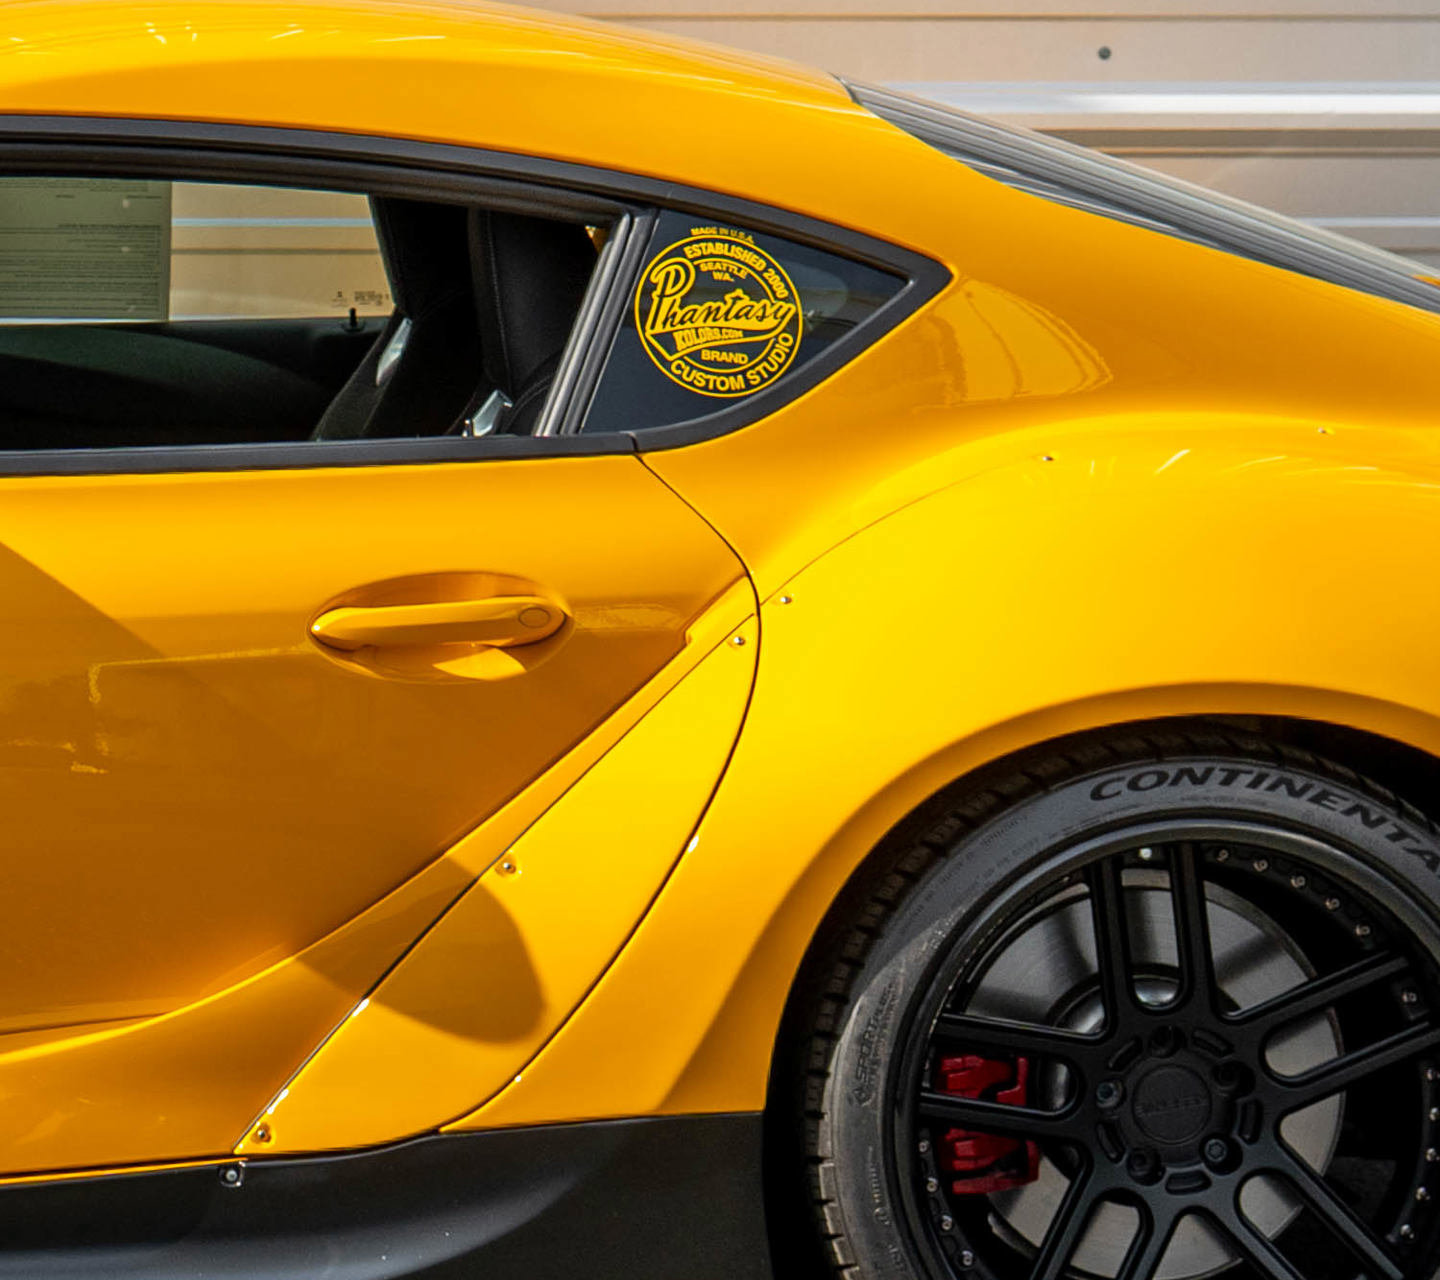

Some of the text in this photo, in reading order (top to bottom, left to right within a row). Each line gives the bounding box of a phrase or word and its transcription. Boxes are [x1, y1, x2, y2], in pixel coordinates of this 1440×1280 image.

[690, 227, 717, 236] MADE
[683, 242, 789, 299] ESTABLISHED 2000
[699, 262, 749, 280] SEATTLE
[649, 257, 797, 334] Phantasy
[671, 332, 794, 391] CUSTOM STUDIO
[700, 349, 749, 365] BRAND
